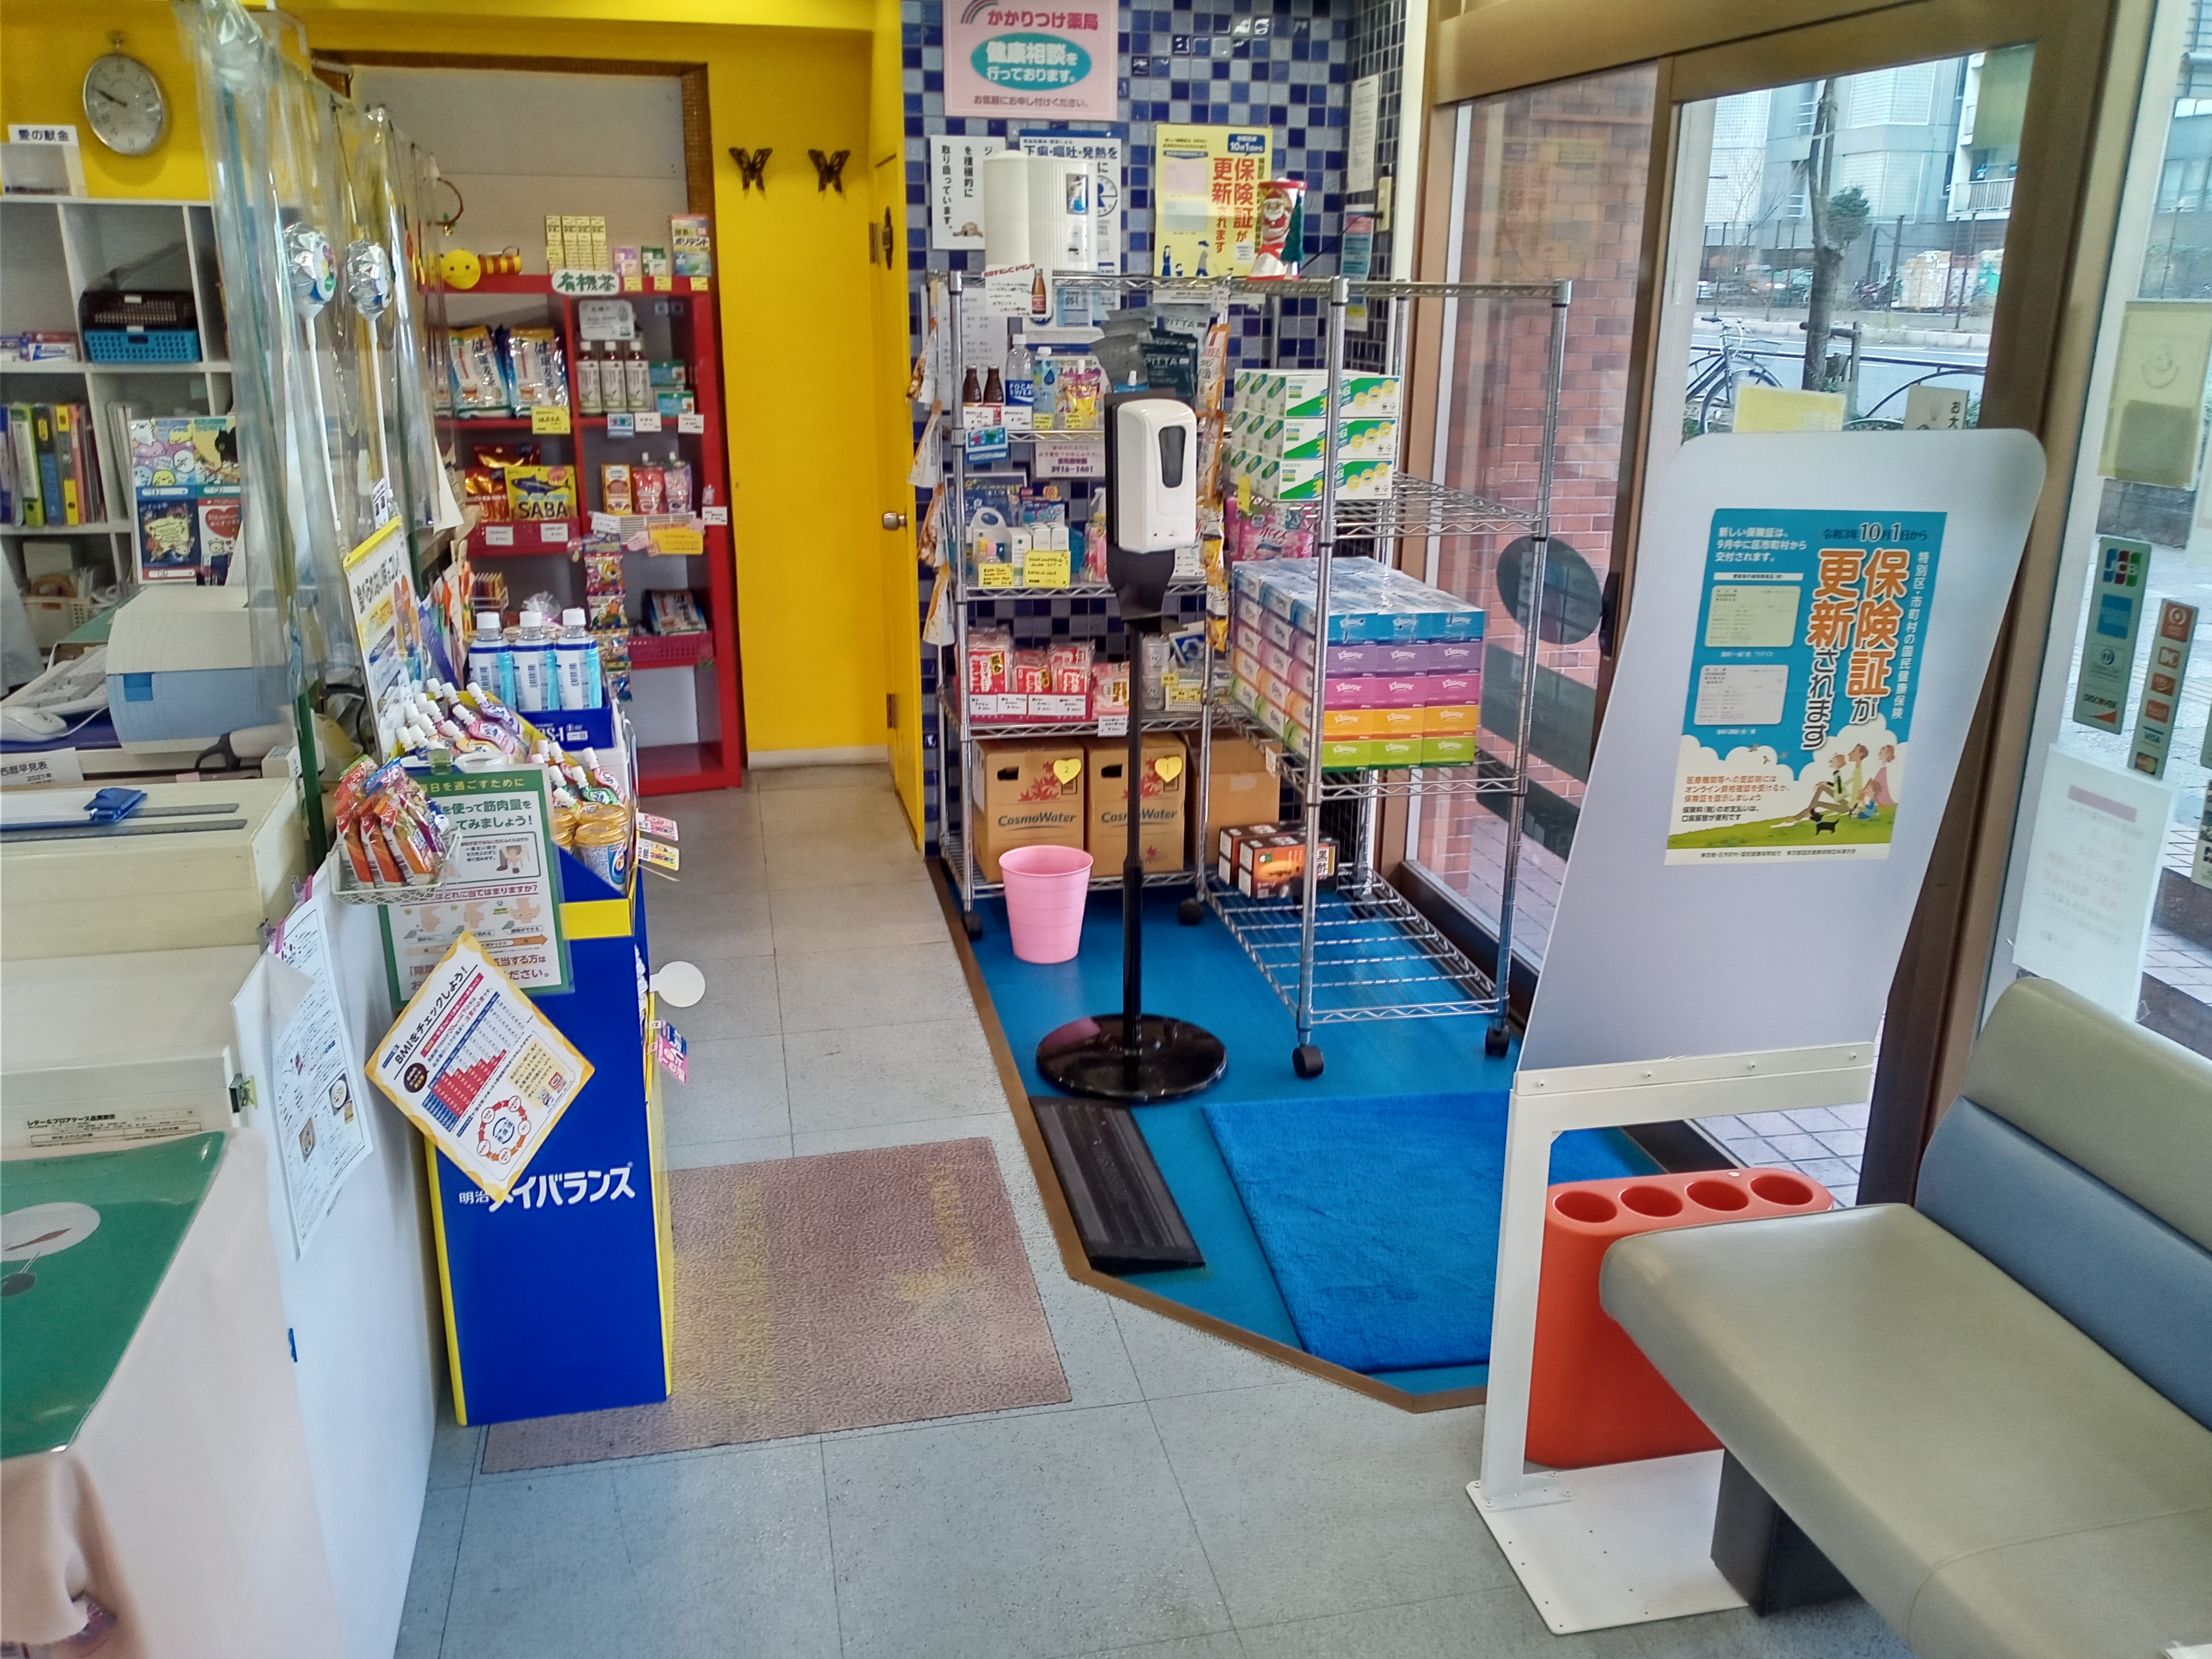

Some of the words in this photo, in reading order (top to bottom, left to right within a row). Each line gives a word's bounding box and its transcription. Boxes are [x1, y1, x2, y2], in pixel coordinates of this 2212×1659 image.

[987, 10, 1099, 30] かかりつけ薬局
[986, 41, 1078, 66] 健康相談を
[986, 67, 1076, 83] 行っております。
[974, 95, 1089, 108] お気軽にお申し付けください。
[963, 146, 974, 198] を積極的に
[1212, 157, 1233, 253] 更新されます
[1233, 157, 1255, 242] 保険証が
[557, 272, 615, 292] 有機茶
[1165, 319, 1194, 328] PITTA
[518, 501, 568, 518] SABA
[1715, 552, 1775, 562] 交付されます。
[1846, 546, 1911, 724] 保険証が
[1891, 551, 1930, 720] 特別区・市町村の国民健康保険
[1801, 548, 1868, 750] 更新されます
[1064, 766, 1070, 774] 2
[998, 812, 1077, 827] CosmoWater
[1101, 808, 1178, 823] CosWater
[459, 1191, 489, 1205] 明治
[489, 1166, 636, 1212] メイバランス
